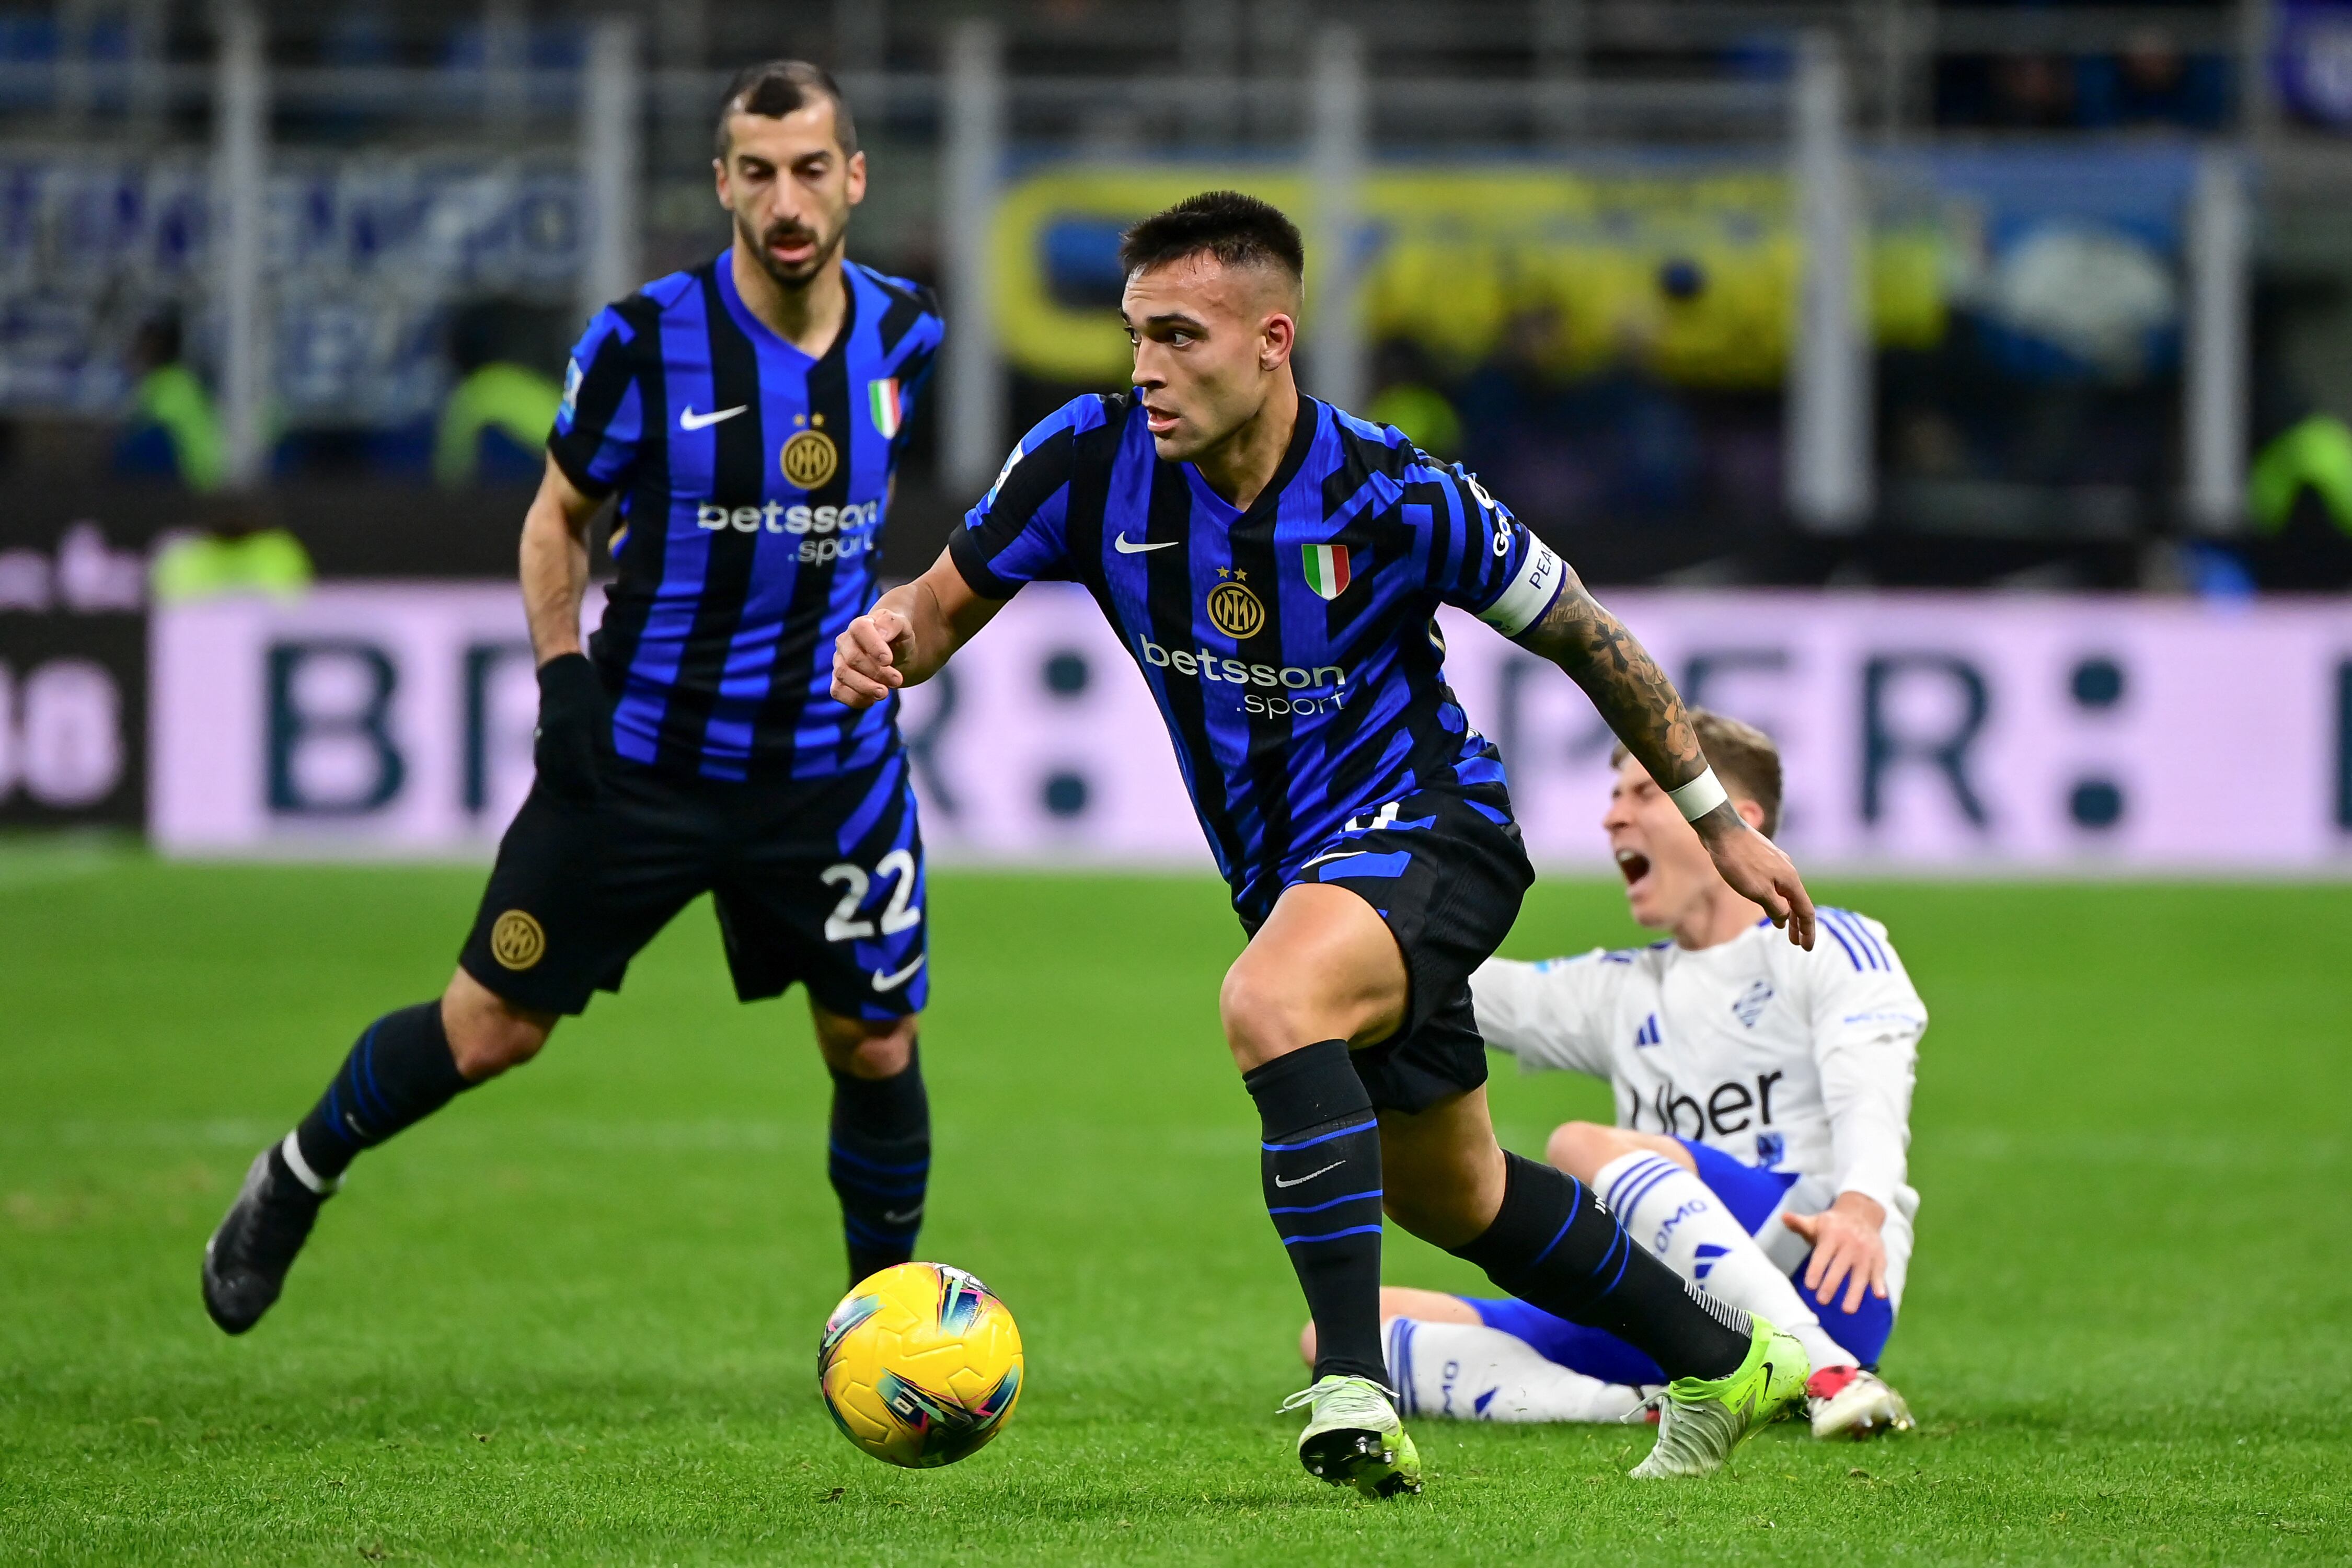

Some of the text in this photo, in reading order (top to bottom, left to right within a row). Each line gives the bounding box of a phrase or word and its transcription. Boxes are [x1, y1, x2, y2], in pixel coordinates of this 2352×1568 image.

[1139, 633, 1346, 688] betsson
[1237, 690, 1345, 719] .sport
[821, 848, 920, 942] 22
[1653, 1198, 1708, 1254] OMO
